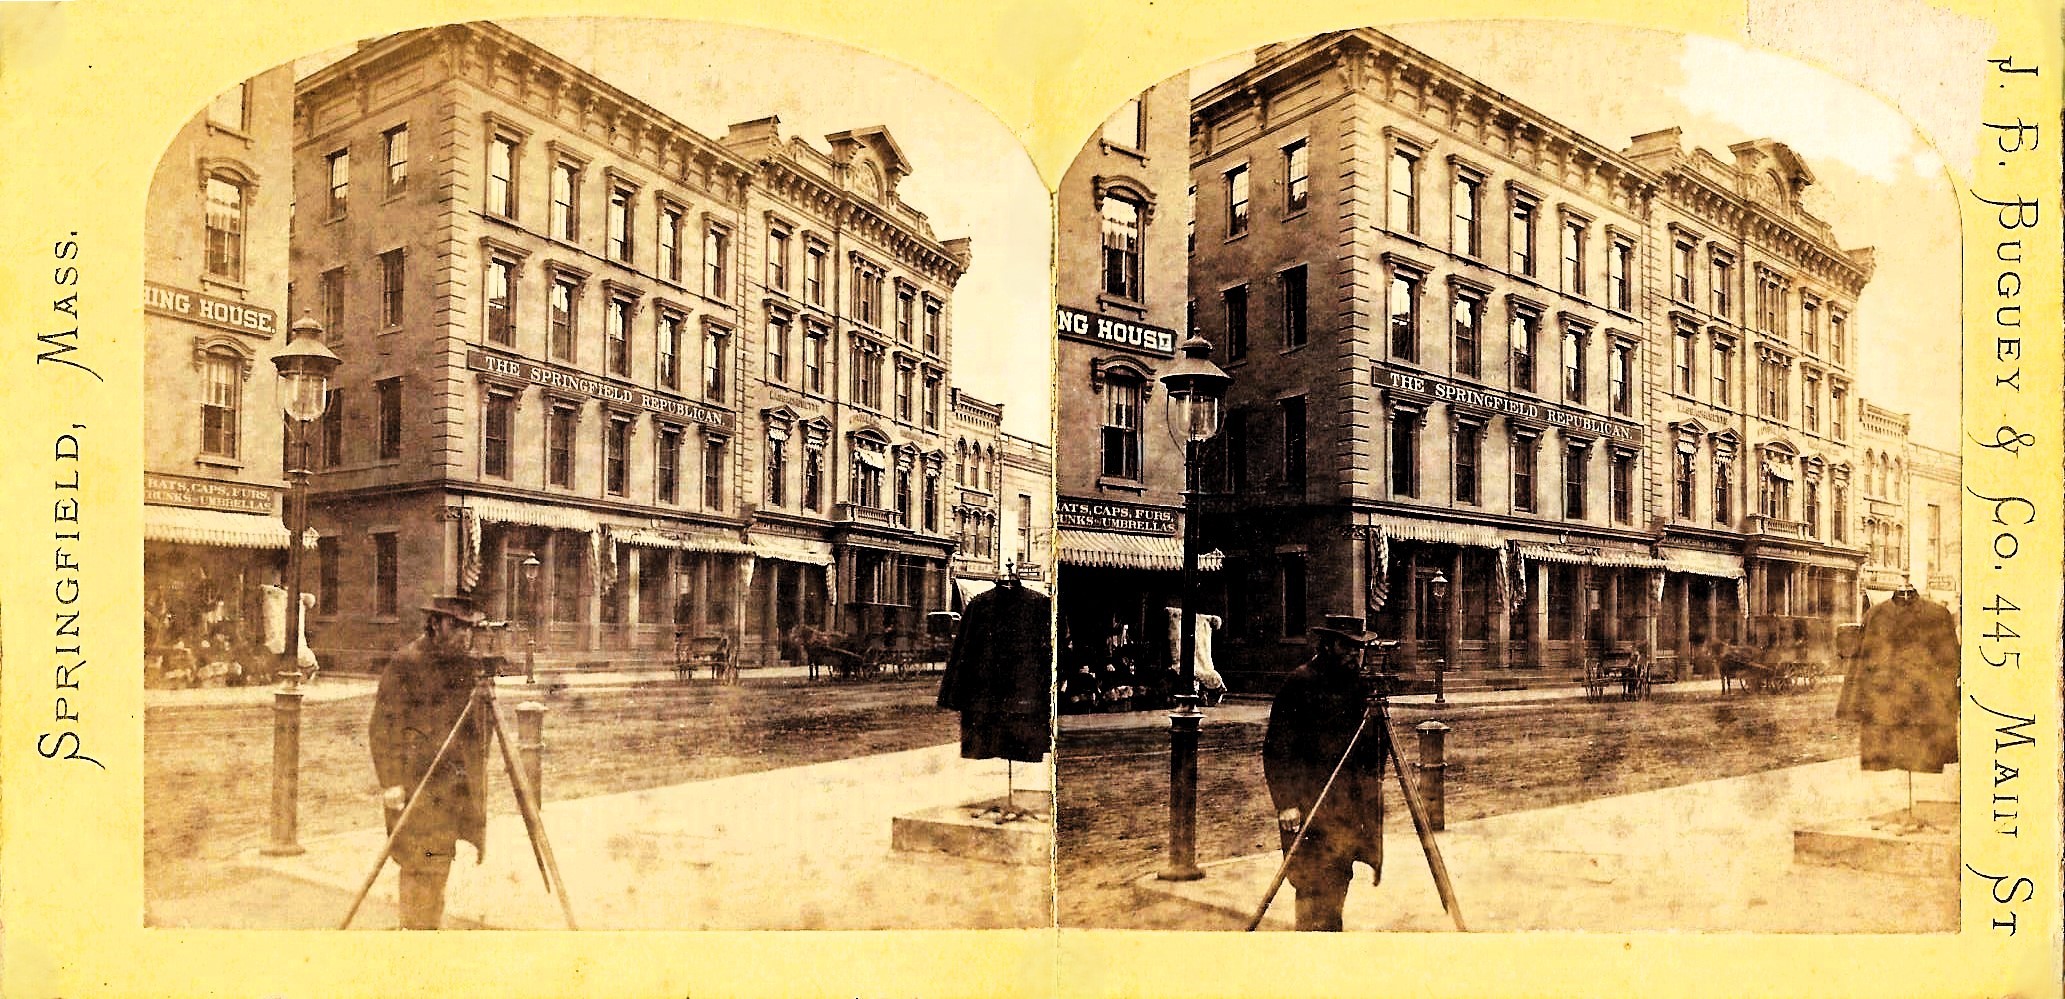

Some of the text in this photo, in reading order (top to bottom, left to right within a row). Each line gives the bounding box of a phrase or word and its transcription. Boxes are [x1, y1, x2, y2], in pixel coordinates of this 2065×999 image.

[1987, 56, 2038, 88] J.
[199, 298, 276, 334] HOUSE.
[485, 355, 725, 426] THE SPRINGFIELD REPUBLICAN.
[1390, 372, 1633, 441] THE SPRINGFIELD REPUBLICAN.
[1967, 425, 2035, 459] &
[37, 230, 105, 770] SPRINGFIELD, MASS.
[1093, 504, 1132, 519] CAPS,
[1135, 509, 1174, 524] FURS,
[1102, 517, 1177, 532] UMBRELLAS
[1979, 594, 2021, 669] 445
